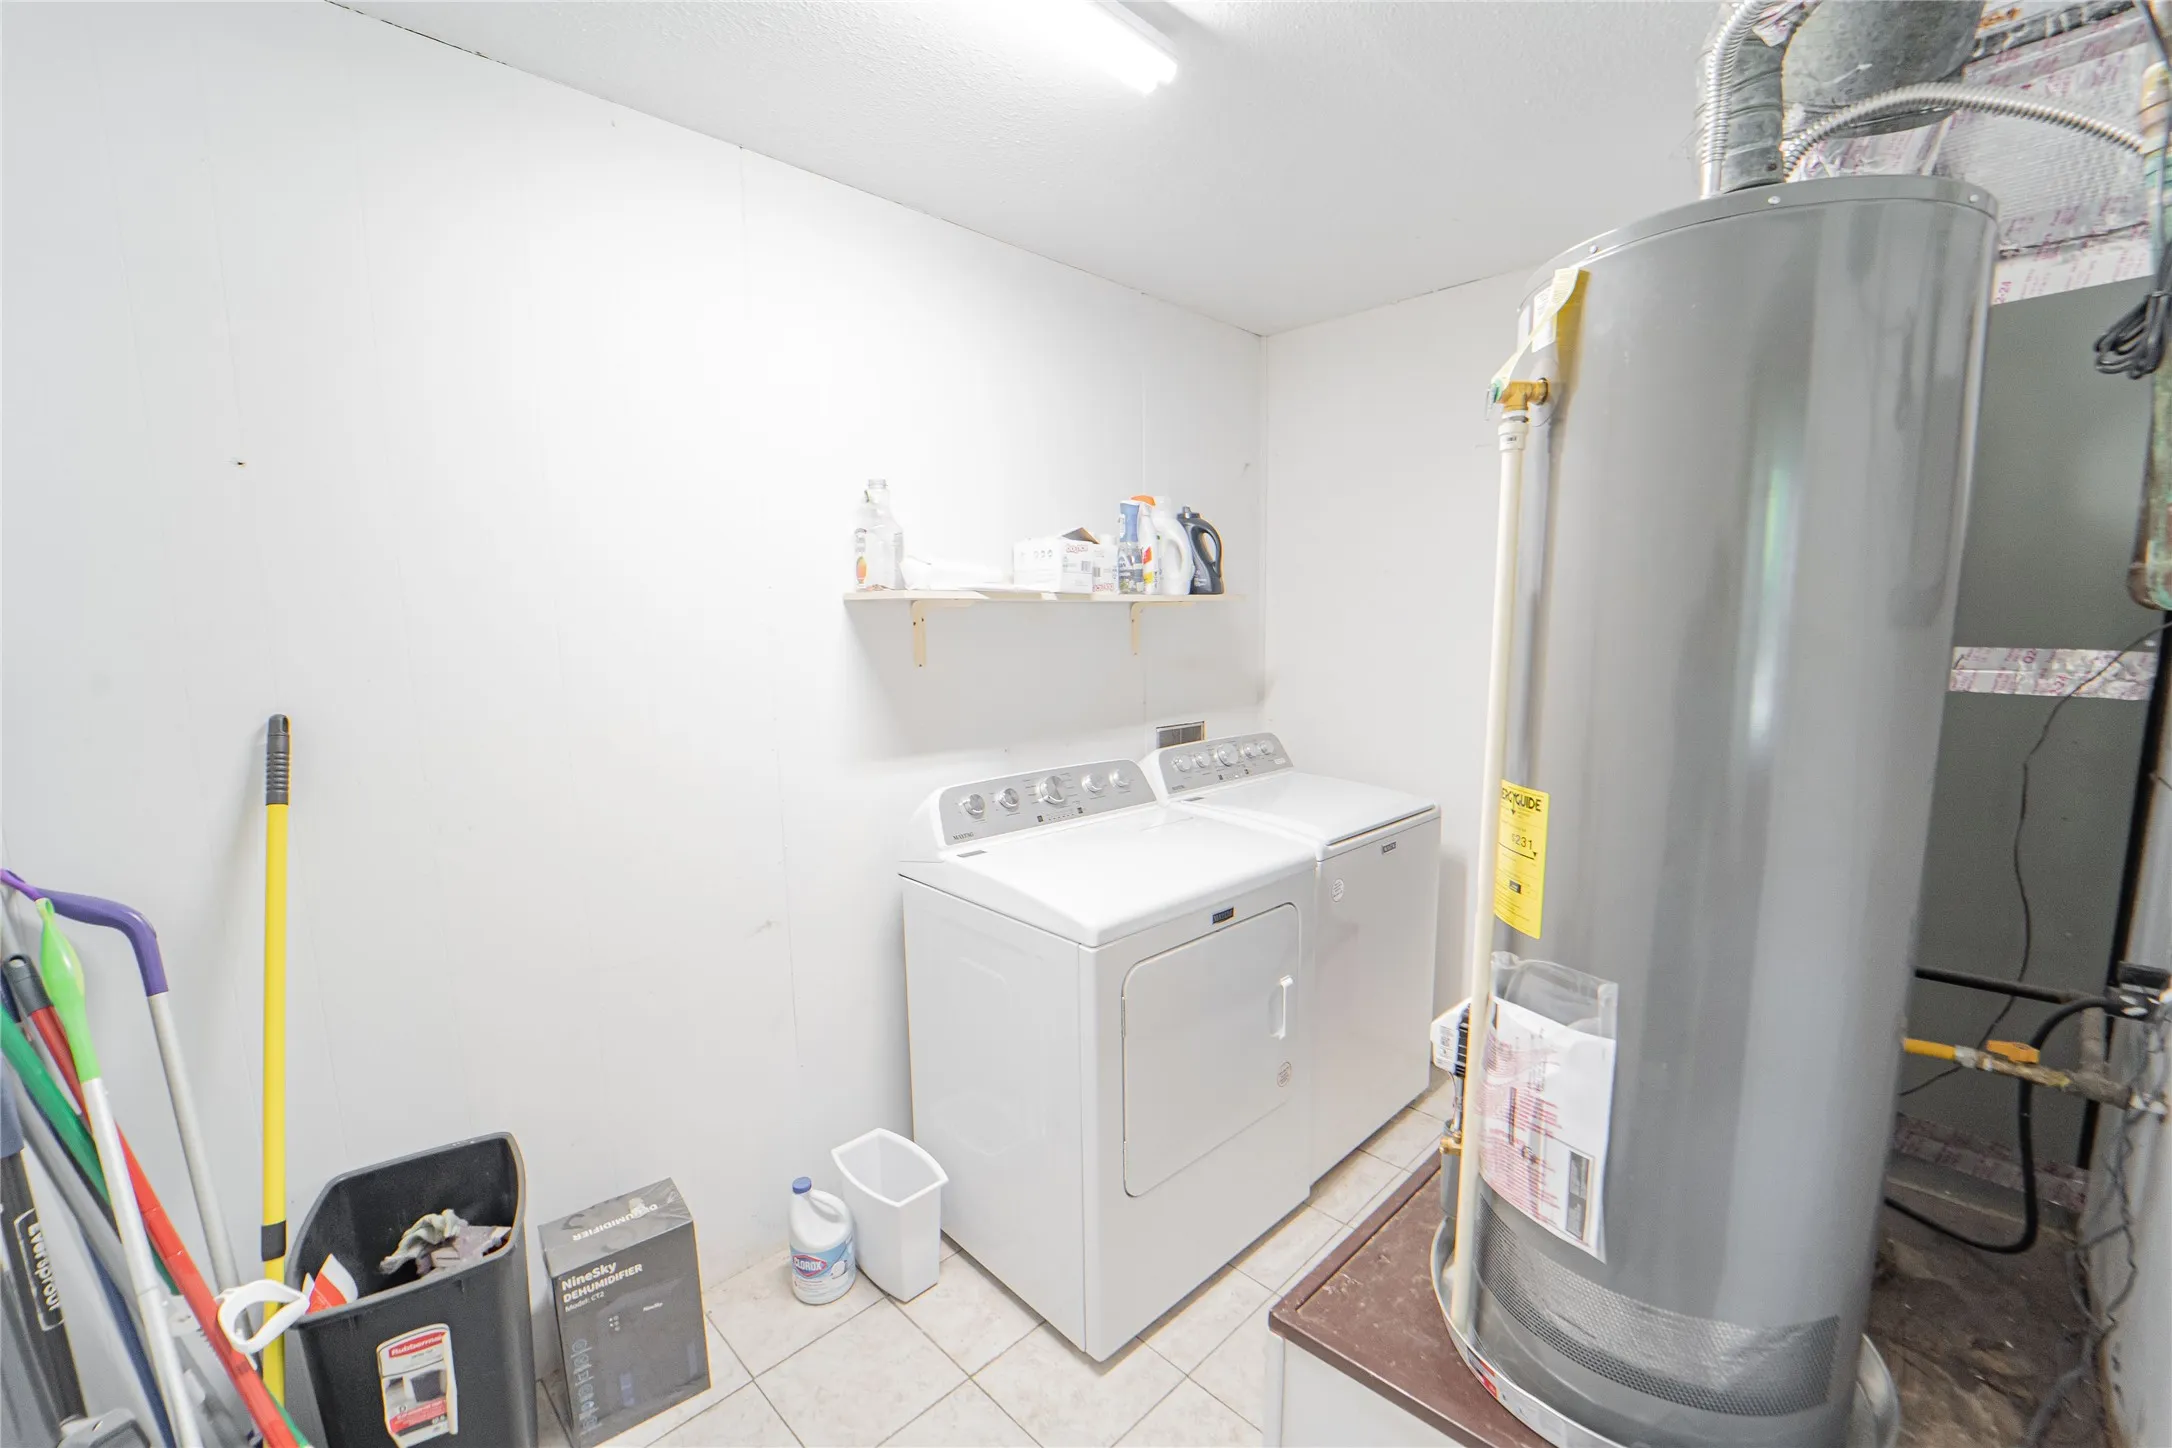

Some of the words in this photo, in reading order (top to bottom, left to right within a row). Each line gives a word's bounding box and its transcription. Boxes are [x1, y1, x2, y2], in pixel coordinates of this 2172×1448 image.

[562, 1262, 617, 1291] NineSky
[563, 1263, 643, 1303] DEHUMIDIFIER
[565, 1298, 590, 1312] Model:
[591, 1291, 605, 1301] CT2
